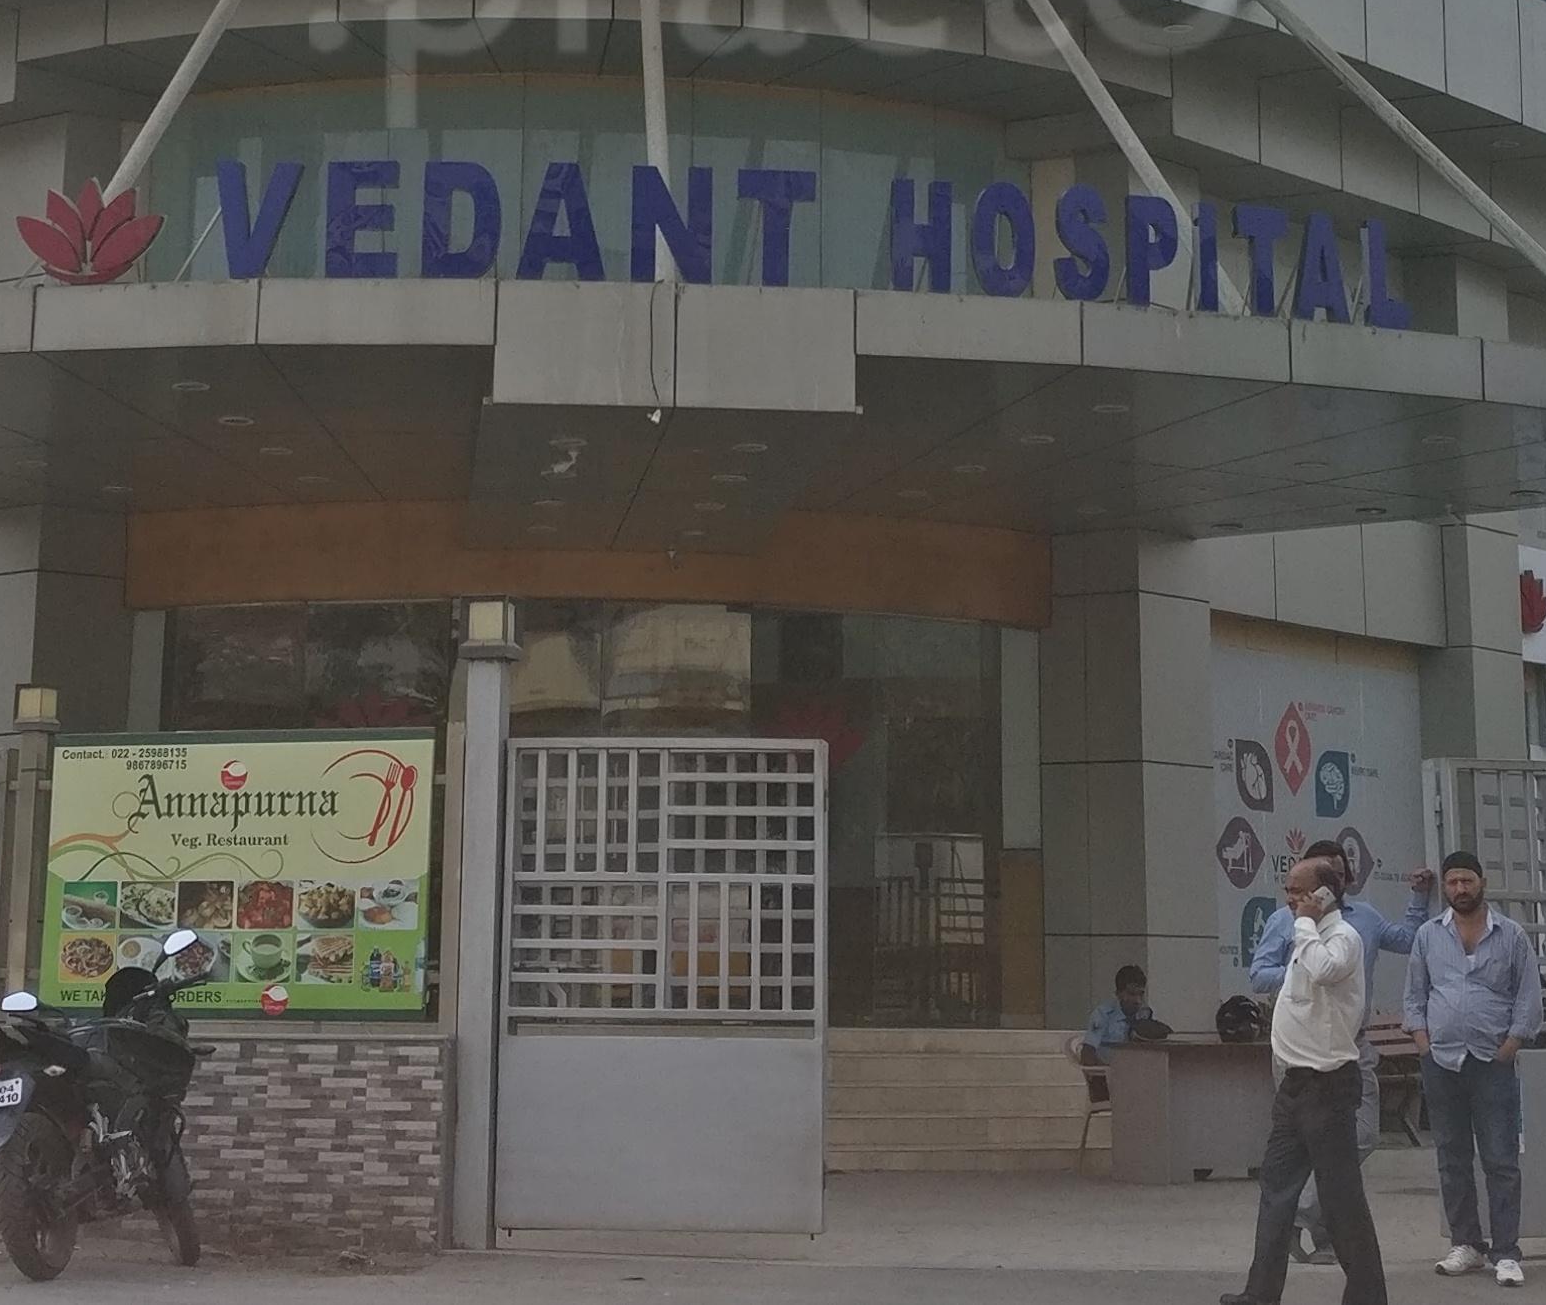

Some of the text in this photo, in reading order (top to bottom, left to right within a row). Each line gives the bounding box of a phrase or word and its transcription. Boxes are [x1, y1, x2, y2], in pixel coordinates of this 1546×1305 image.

[216, 159, 1413, 330] VEDANT HOSPITAL
[111, 748, 130, 759] 022
[127, 774, 340, 833] Annapurna
[171, 832, 289, 850] Veg. Restaurant
[61, 989, 81, 1001] WE
[0, 1084, 14, 1095] 04
